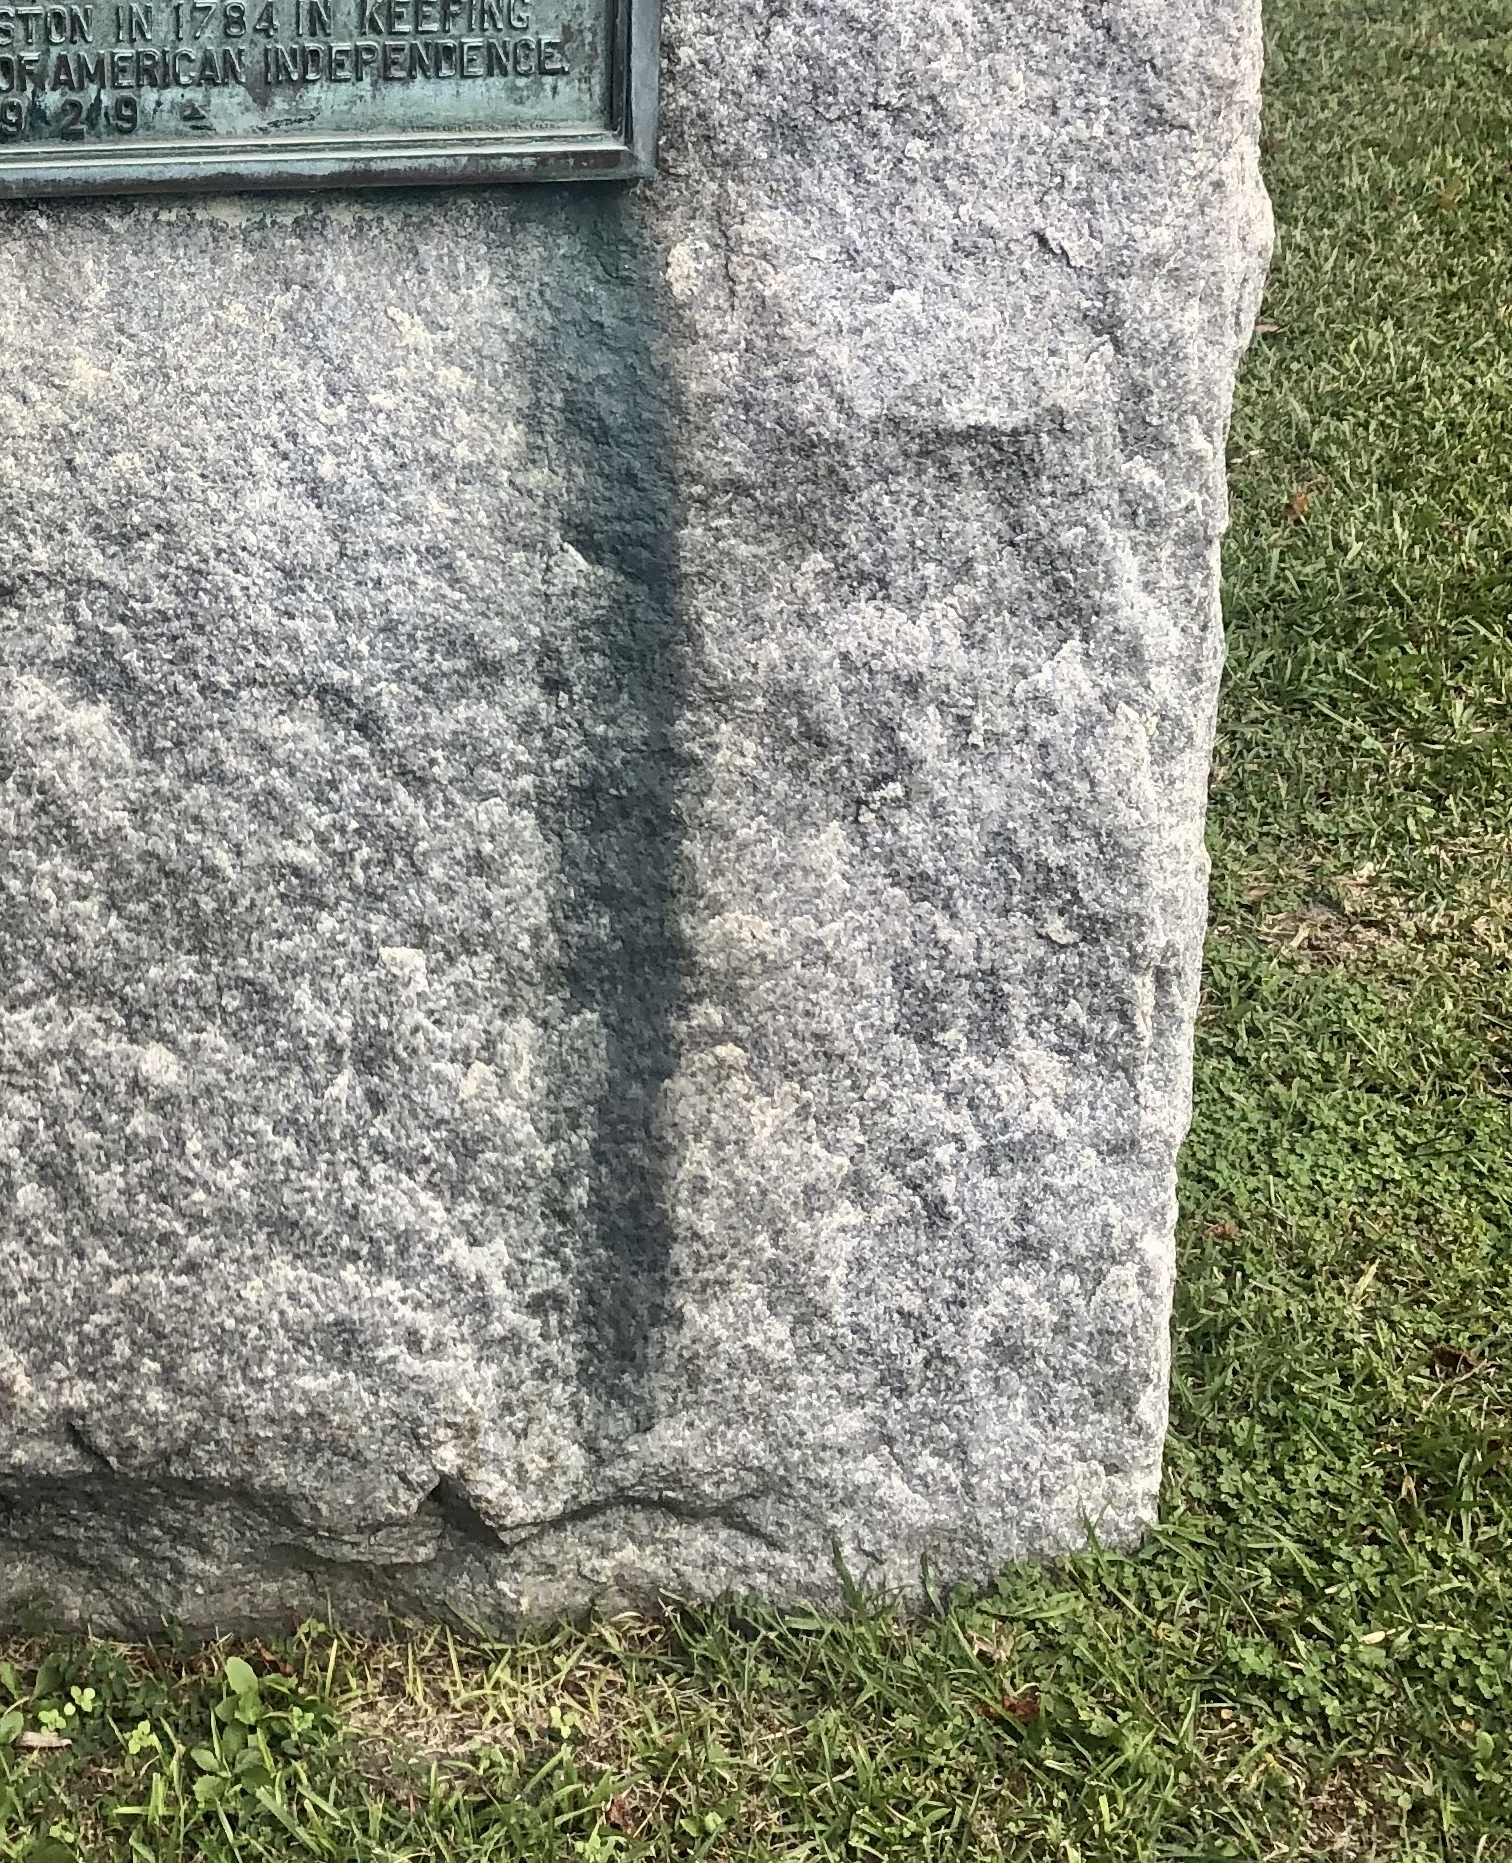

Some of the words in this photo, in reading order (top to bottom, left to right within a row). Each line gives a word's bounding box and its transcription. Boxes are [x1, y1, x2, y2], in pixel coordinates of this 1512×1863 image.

[116, 4, 153, 43] IN
[52, 47, 246, 92] AMERICAN
[264, 38, 570, 85] INDEPENDENCE.
